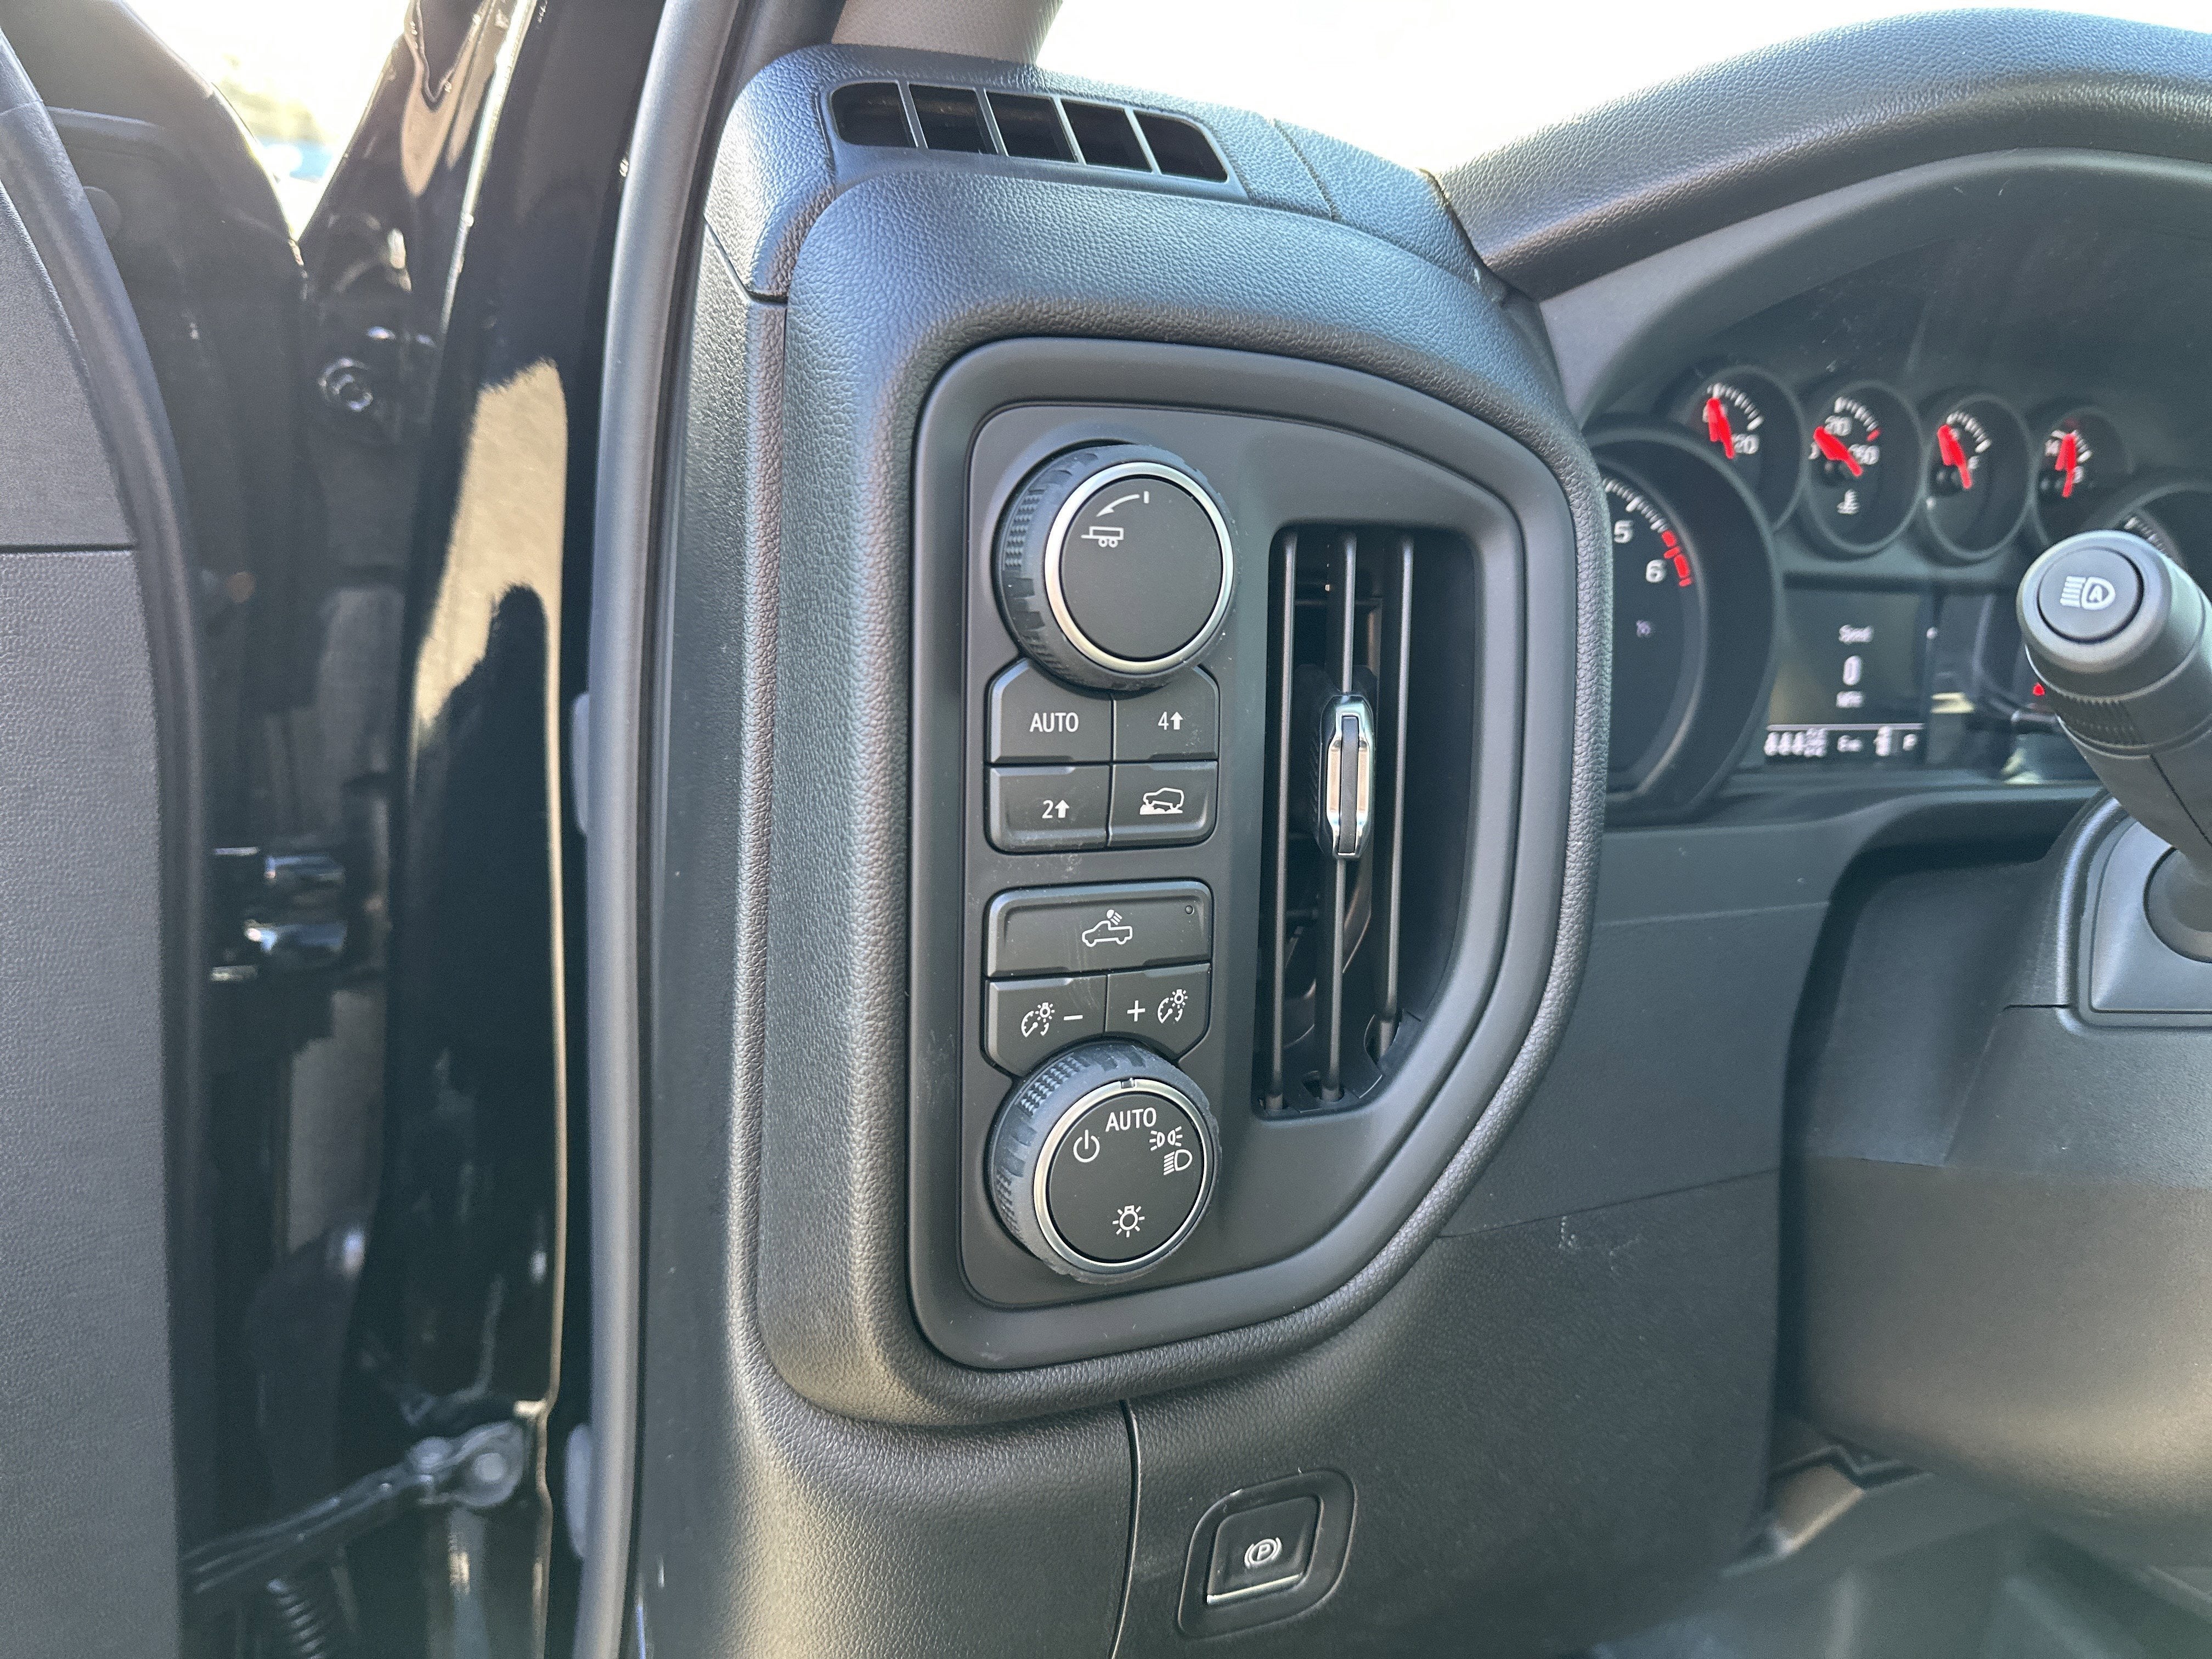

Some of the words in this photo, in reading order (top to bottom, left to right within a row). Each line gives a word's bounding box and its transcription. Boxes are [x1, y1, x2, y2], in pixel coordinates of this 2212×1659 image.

[1614, 520, 1633, 543] 5
[1646, 560, 1666, 583] 6
[1029, 712, 1079, 732] AUTO
[1158, 712, 1169, 730] 4
[1042, 800, 1054, 819] 2
[1105, 1107, 1156, 1132] AUTO
